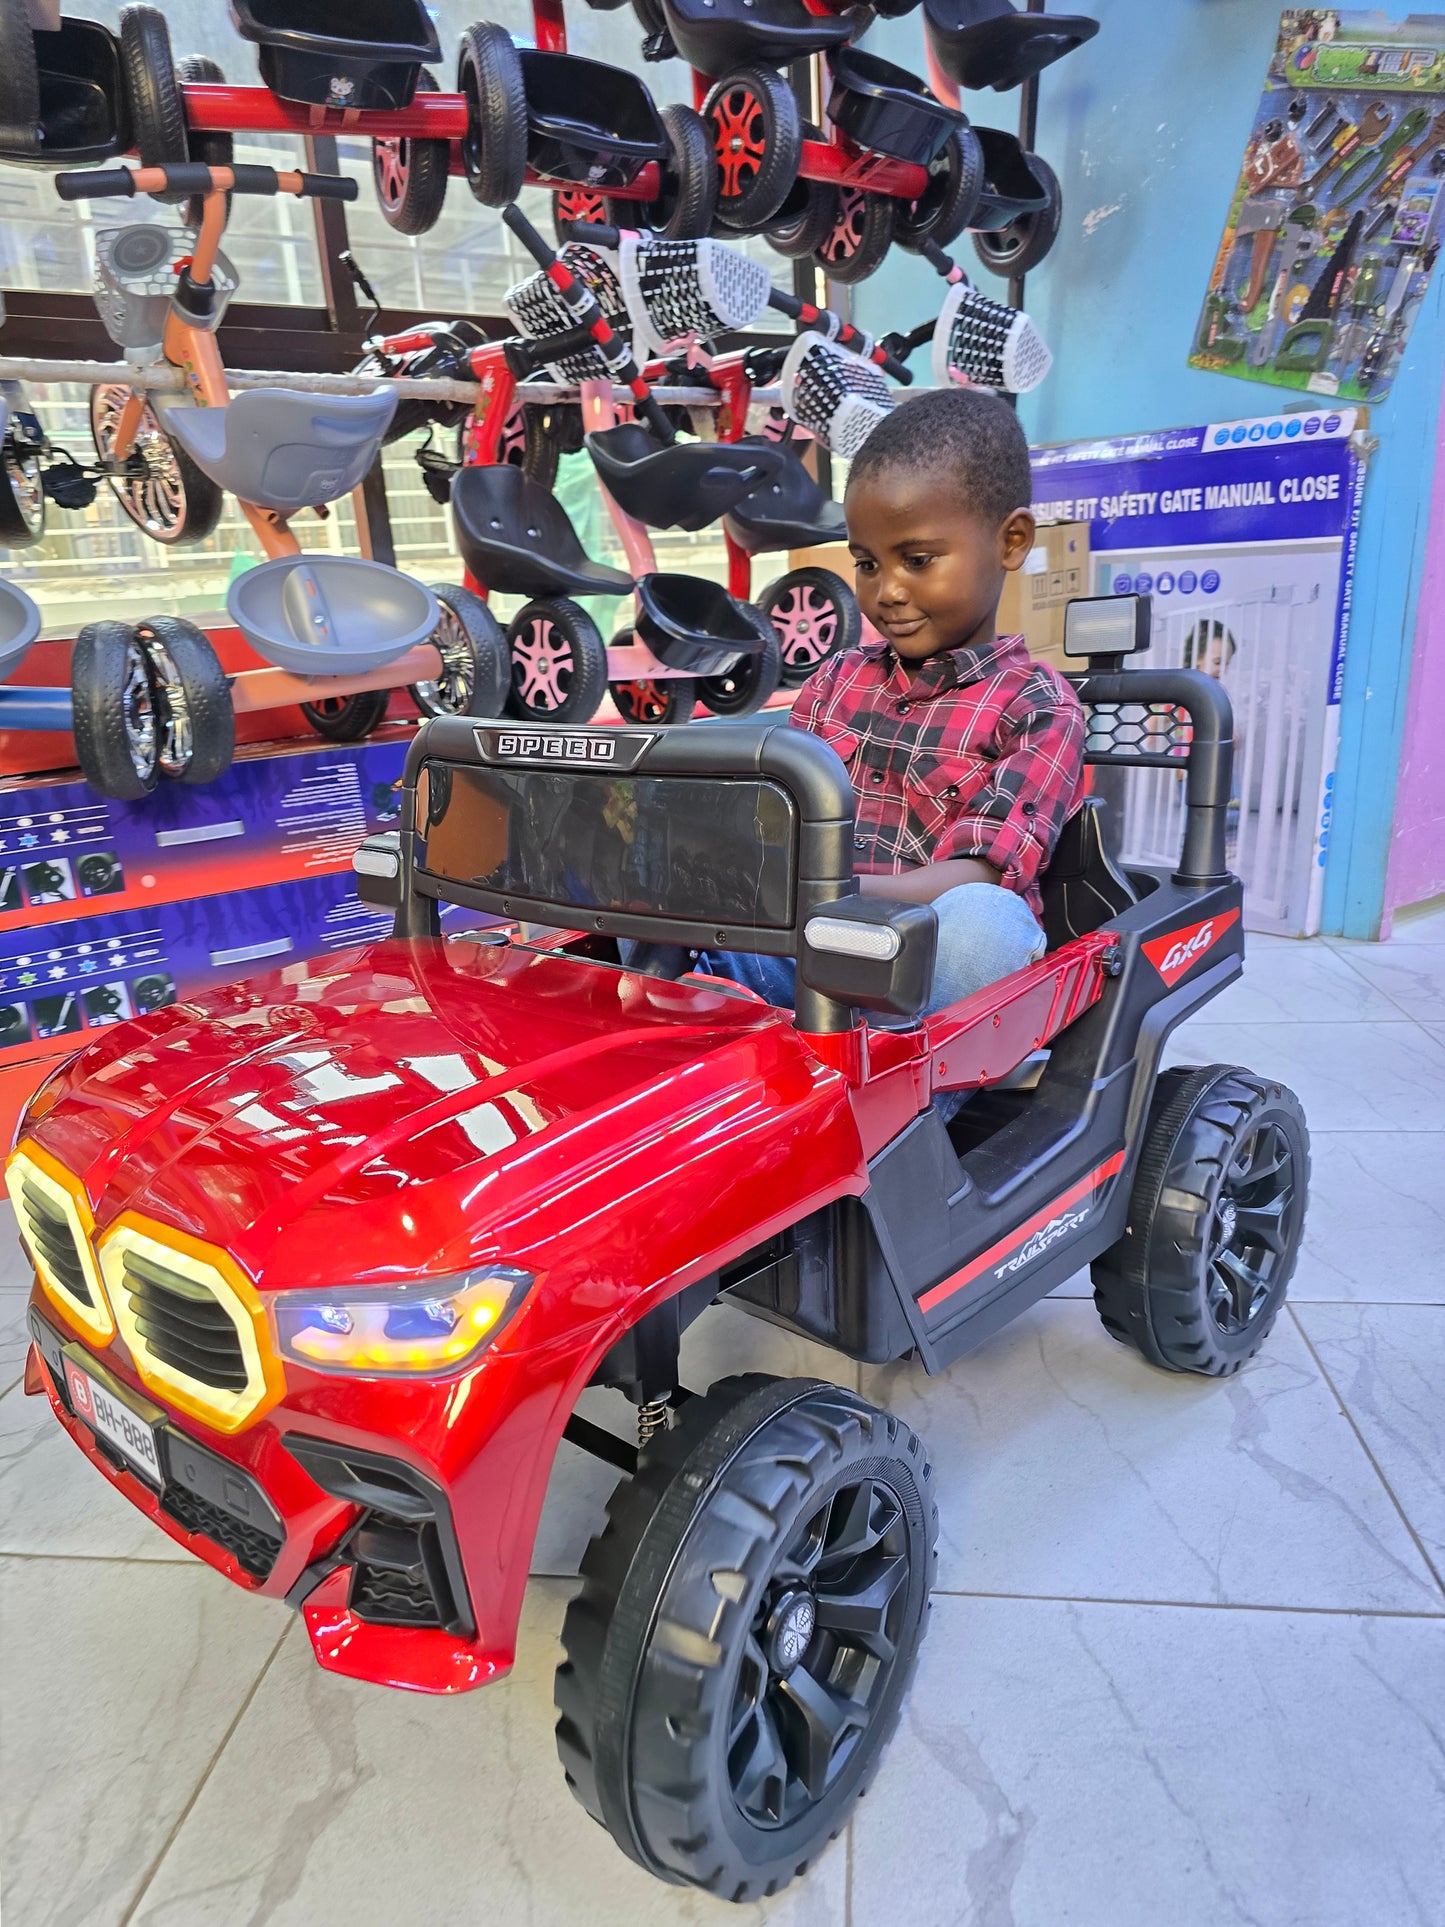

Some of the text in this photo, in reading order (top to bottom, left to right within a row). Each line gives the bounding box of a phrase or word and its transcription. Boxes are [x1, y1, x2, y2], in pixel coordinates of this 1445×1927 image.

[1165, 436, 1199, 451] CLOSE
[1075, 497, 1099, 521] FIT
[1100, 492, 1158, 519] SAFETY
[1160, 487, 1202, 514] GATE
[1204, 481, 1276, 510] MANUAL
[1279, 474, 1340, 504] CLOSE
[1346, 531, 1358, 576] SAFETY
[1342, 579, 1353, 610] GATE
[1337, 612, 1350, 661] MANUAL
[1332, 662, 1344, 700] CLOSE
[498, 735, 616, 760] SPEED
[994, 1208, 1090, 1279] TRAILSPORT
